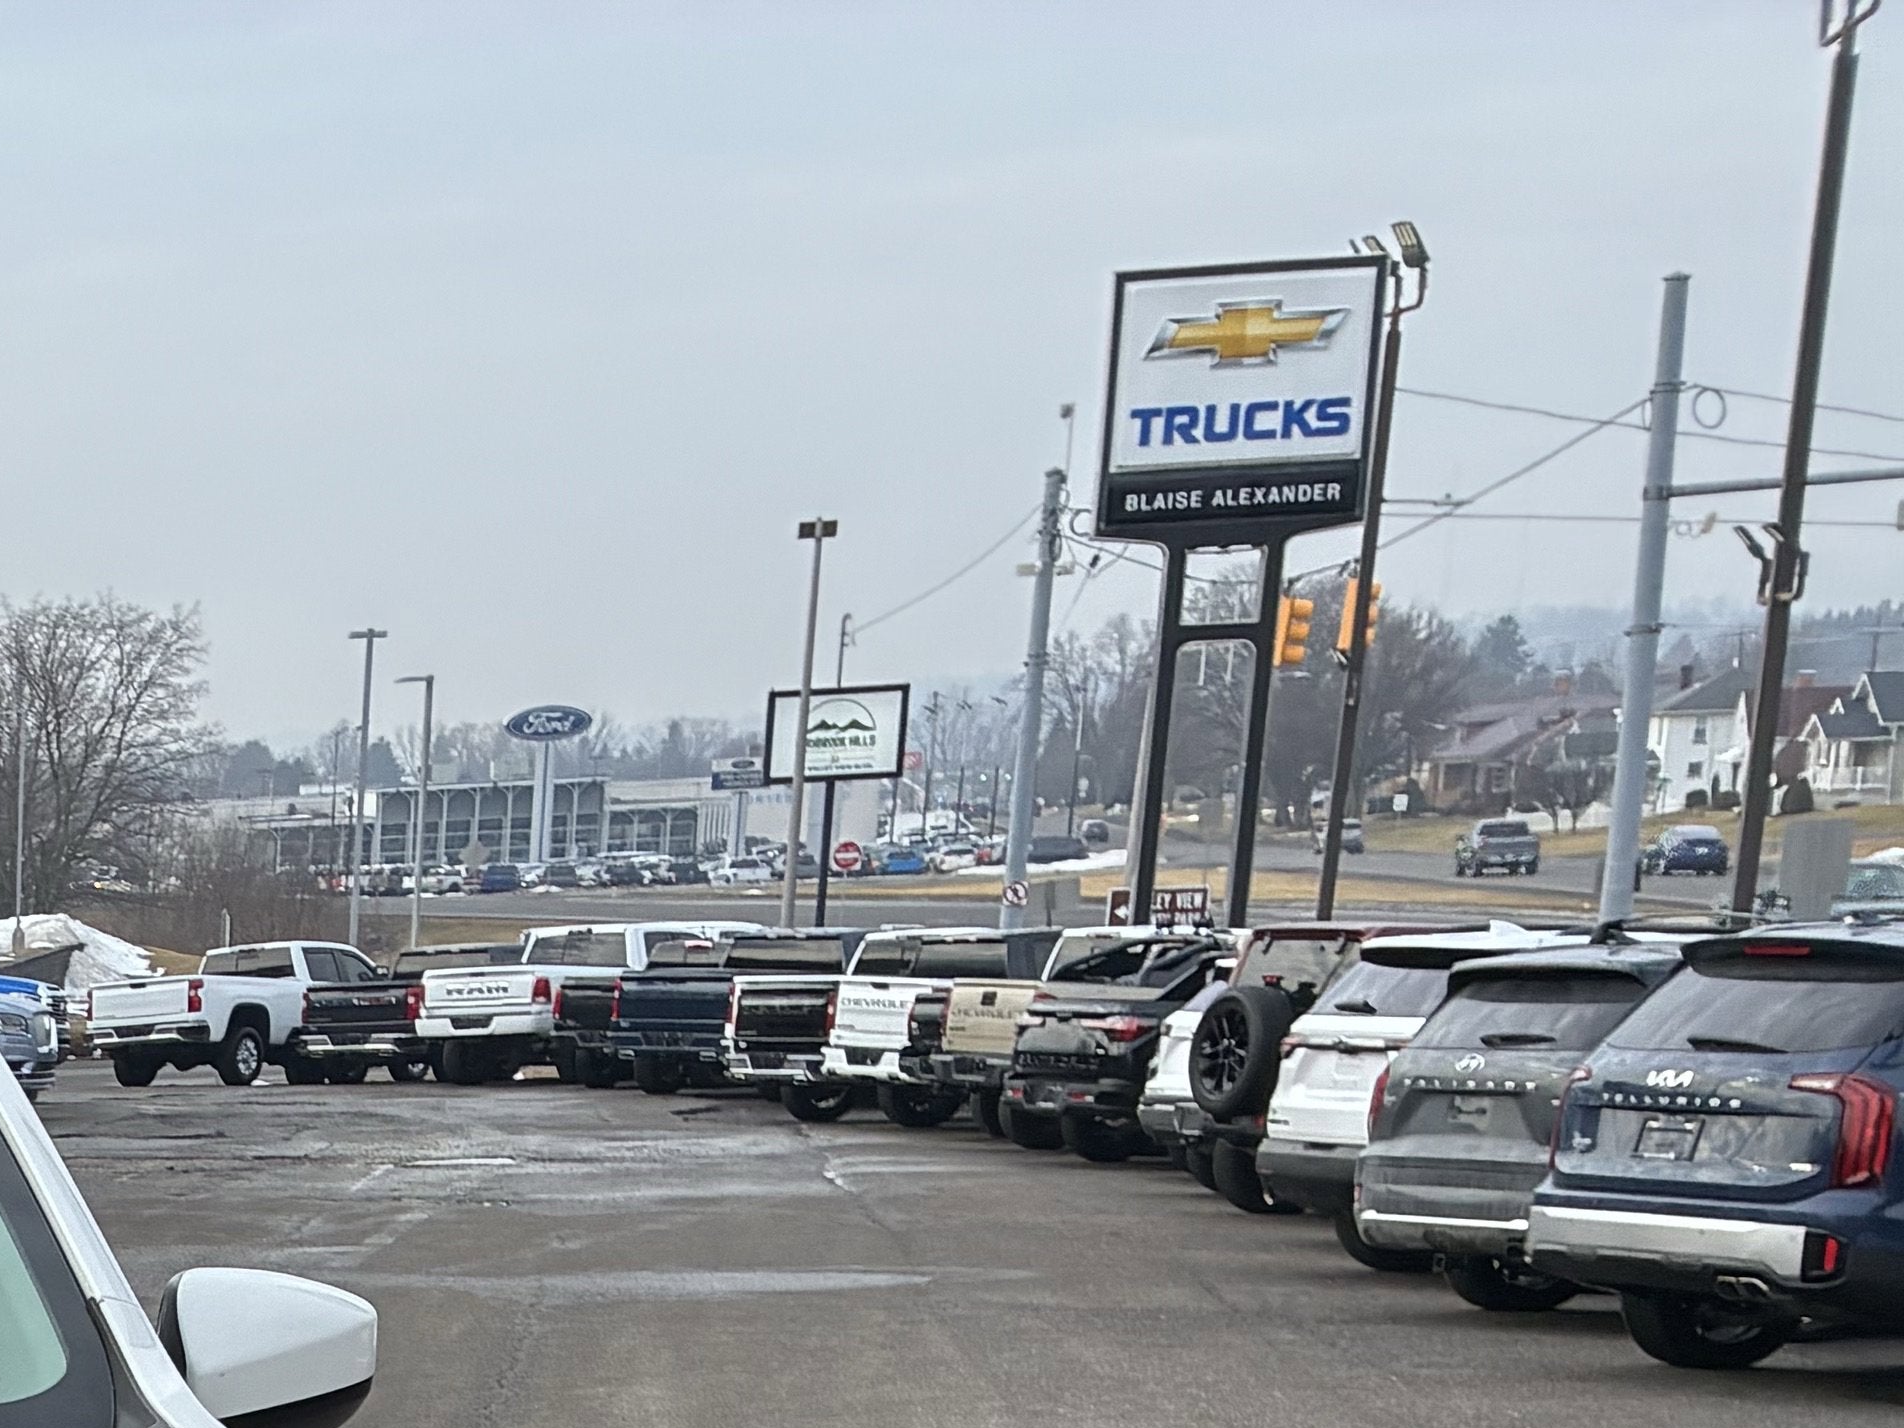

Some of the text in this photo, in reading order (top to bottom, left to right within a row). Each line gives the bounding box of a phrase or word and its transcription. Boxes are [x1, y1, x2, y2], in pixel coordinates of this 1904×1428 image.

[1130, 397, 1352, 447] TRUCKS
[1125, 483, 1342, 512] BLAISE ALEXANDER
[445, 982, 510, 996] RAM
